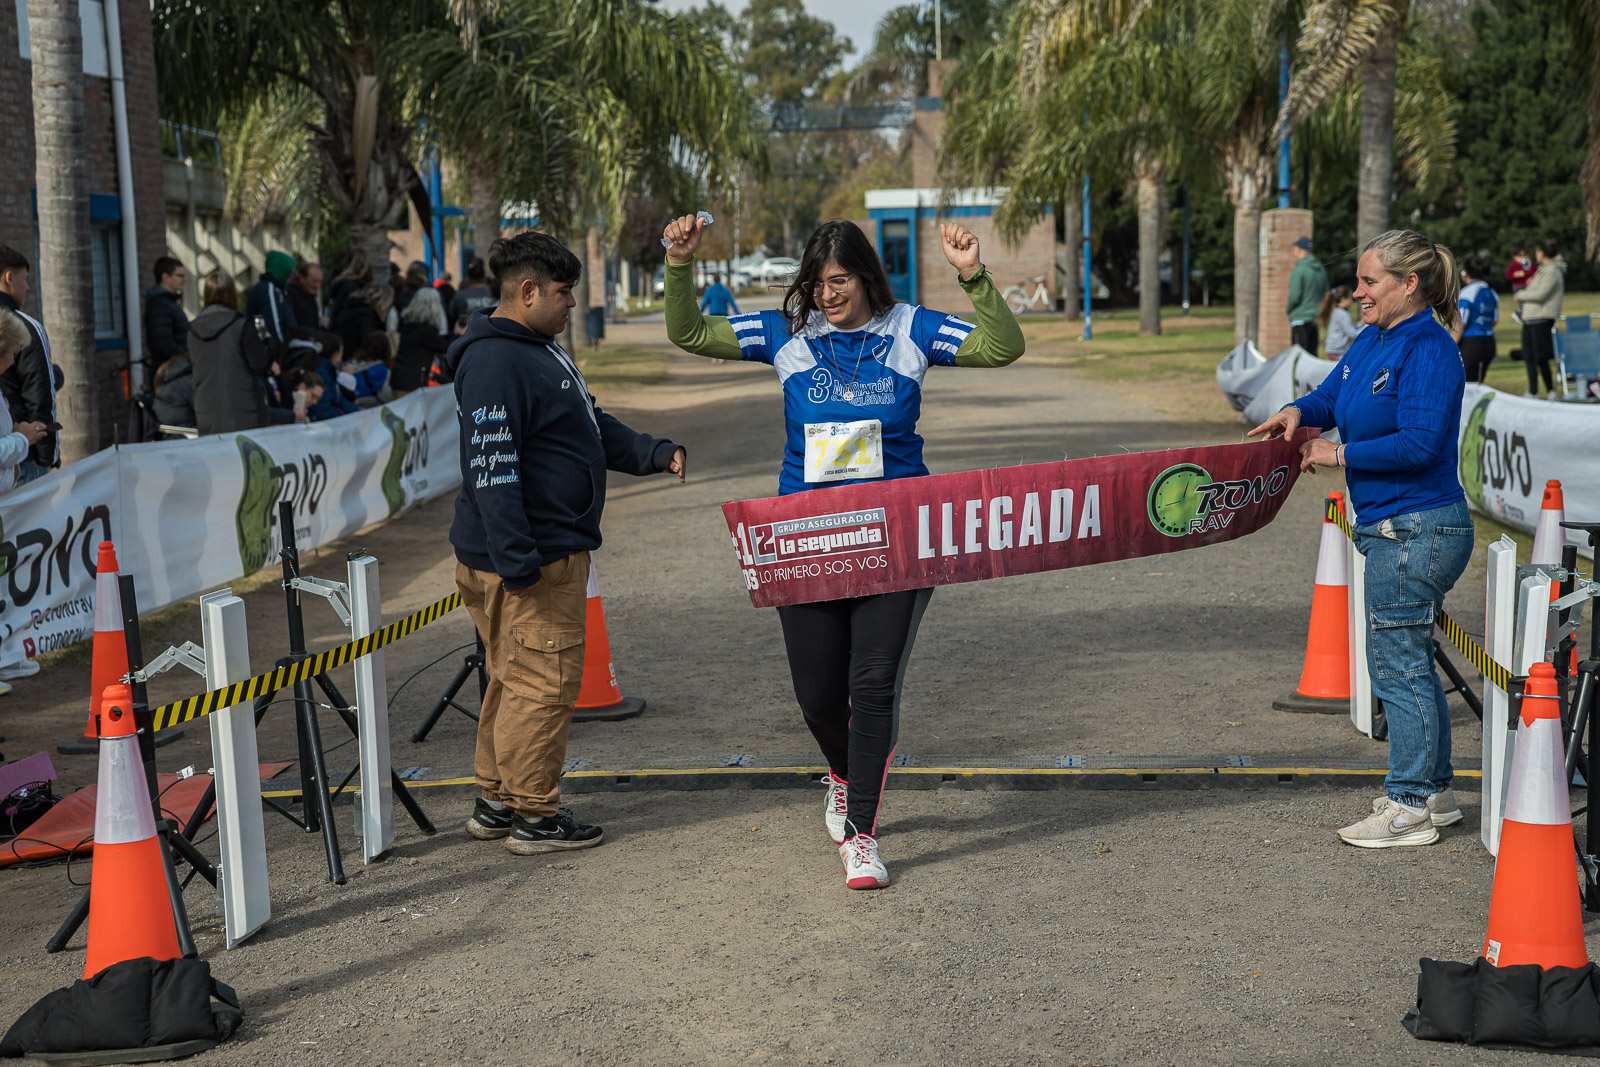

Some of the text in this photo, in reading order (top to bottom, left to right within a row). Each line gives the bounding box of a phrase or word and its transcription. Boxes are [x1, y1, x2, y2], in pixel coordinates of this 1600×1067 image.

[808, 367, 833, 404] 3
[471, 405, 486, 425] El
[488, 404, 507, 421] club
[481, 426, 512, 450] pueblo
[470, 454, 486, 469] más
[814, 436, 872, 468] 731
[475, 471, 488, 489] del
[777, 512, 880, 533] GRUPO ASEGURADOR
[917, 484, 1101, 560] LLEGADA
[1188, 511, 1235, 535] RAV
[779, 526, 882, 555] la segunda
[759, 554, 888, 584] LO PRIMERO SOS VOS
